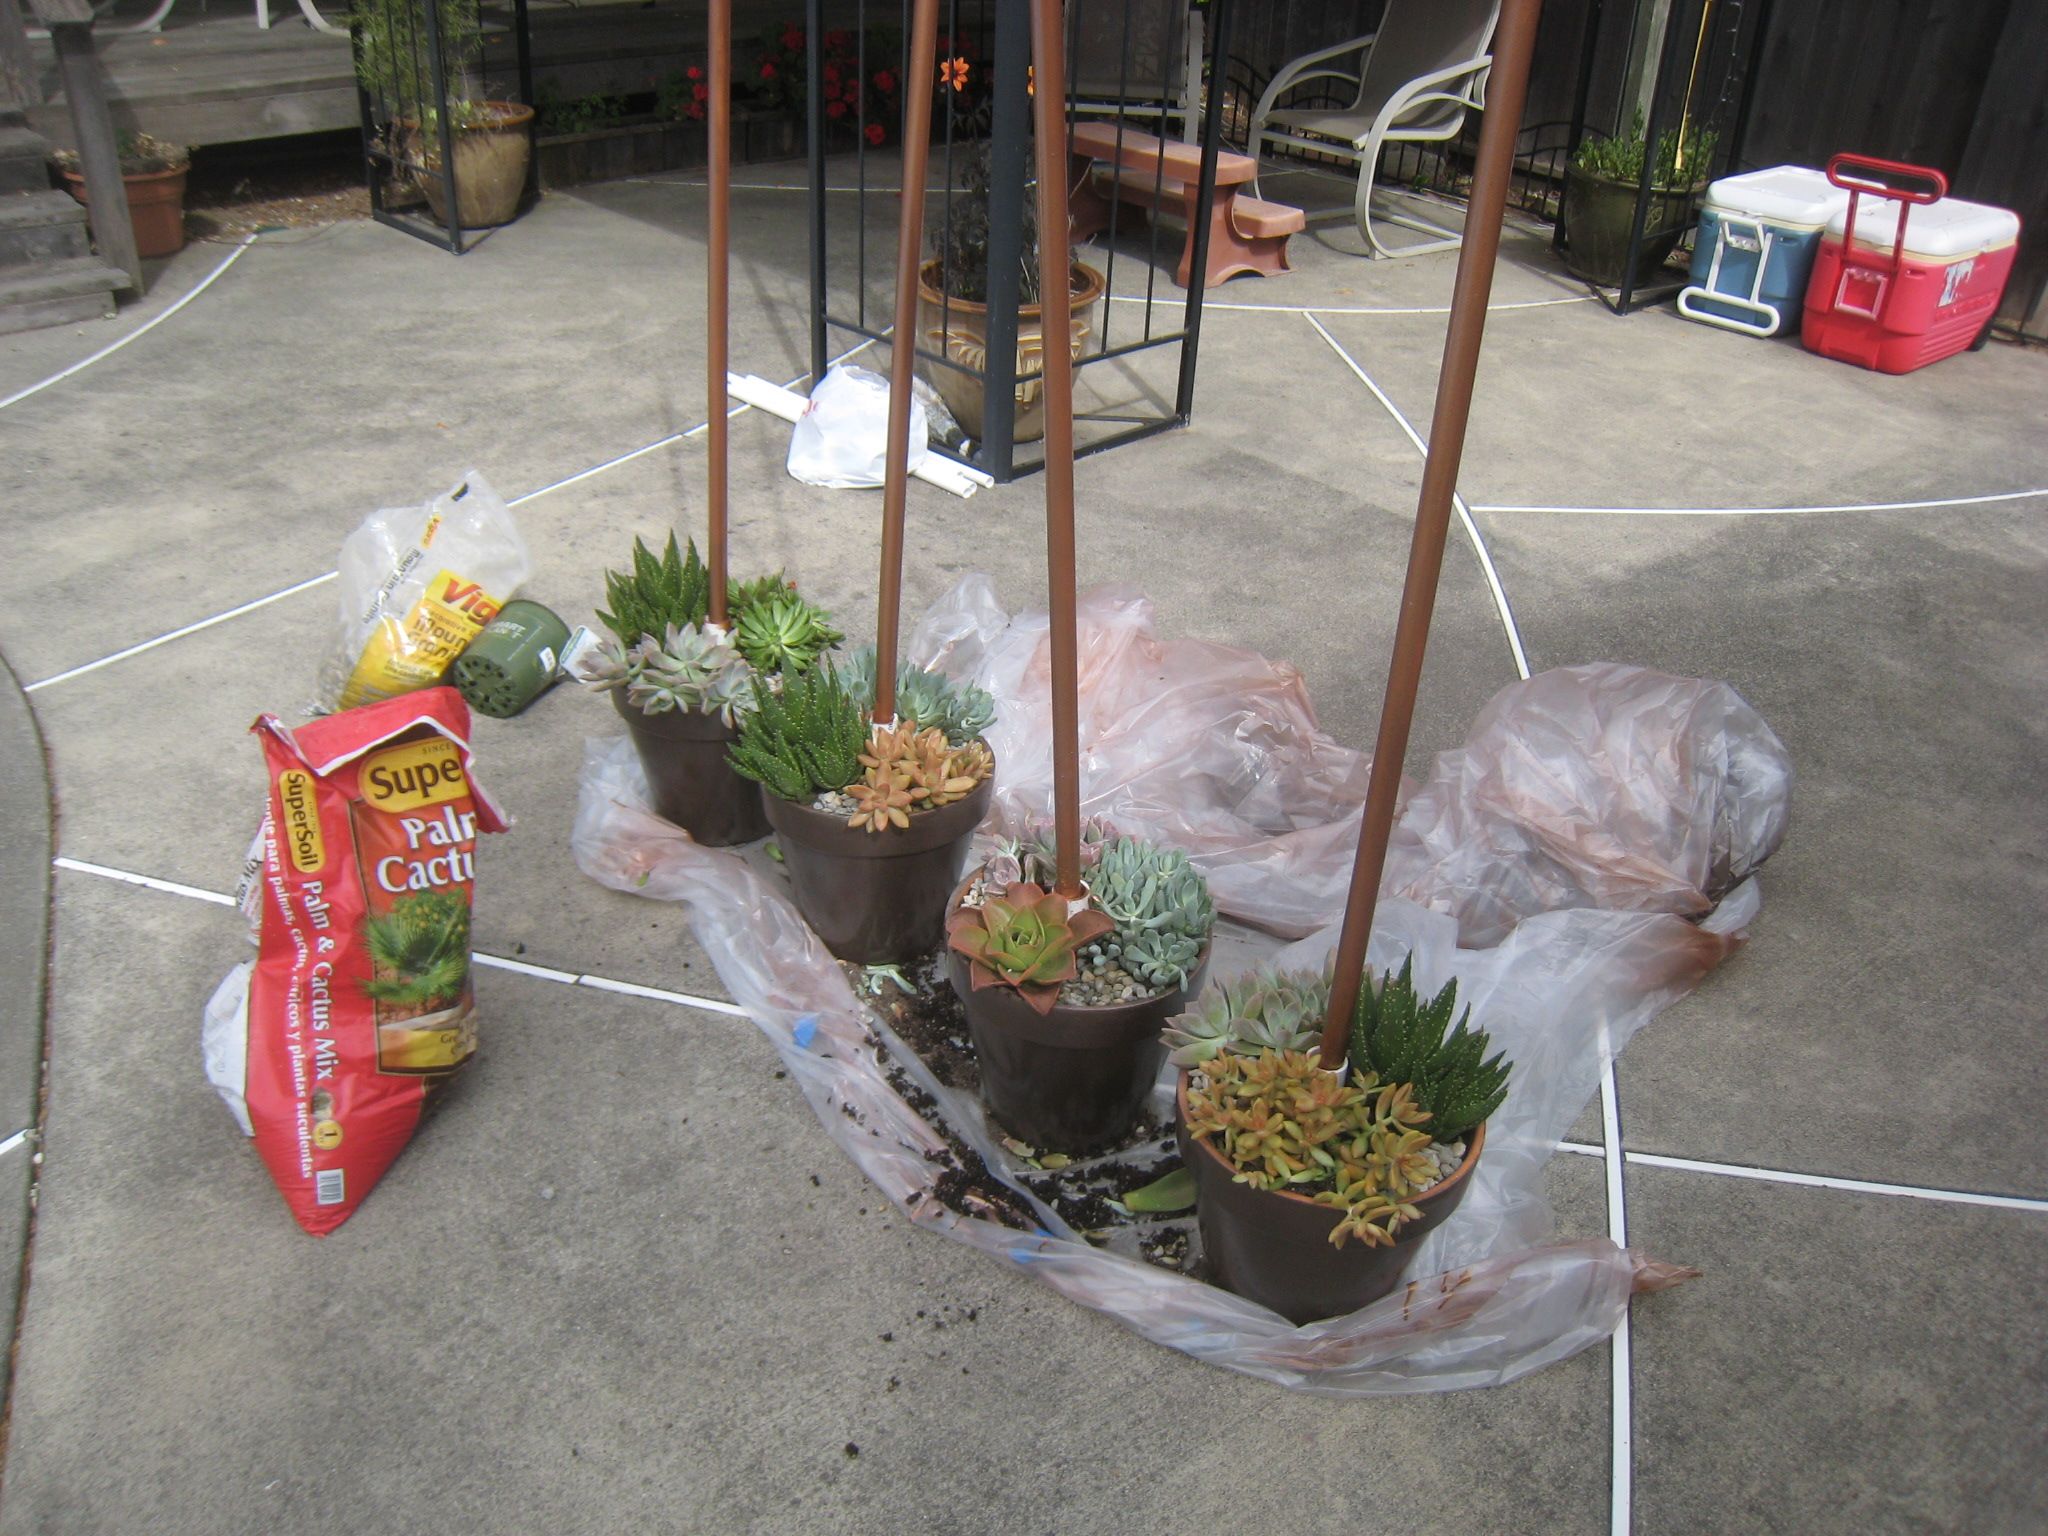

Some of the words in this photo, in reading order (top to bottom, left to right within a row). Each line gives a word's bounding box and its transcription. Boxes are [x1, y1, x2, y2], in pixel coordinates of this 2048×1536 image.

[385, 547, 420, 590] Mounain
[287, 773, 319, 867] SuperSoil
[266, 839, 280, 872] para
[268, 876, 296, 925] palmas,
[302, 880, 330, 930] Palm
[317, 936, 335, 953] &
[312, 961, 333, 1032] Cactus
[286, 1032, 300, 1041] y
[315, 1038, 339, 1080] Mix
[288, 1044, 307, 1097] plantas
[297, 1102, 313, 1178] suculentas
